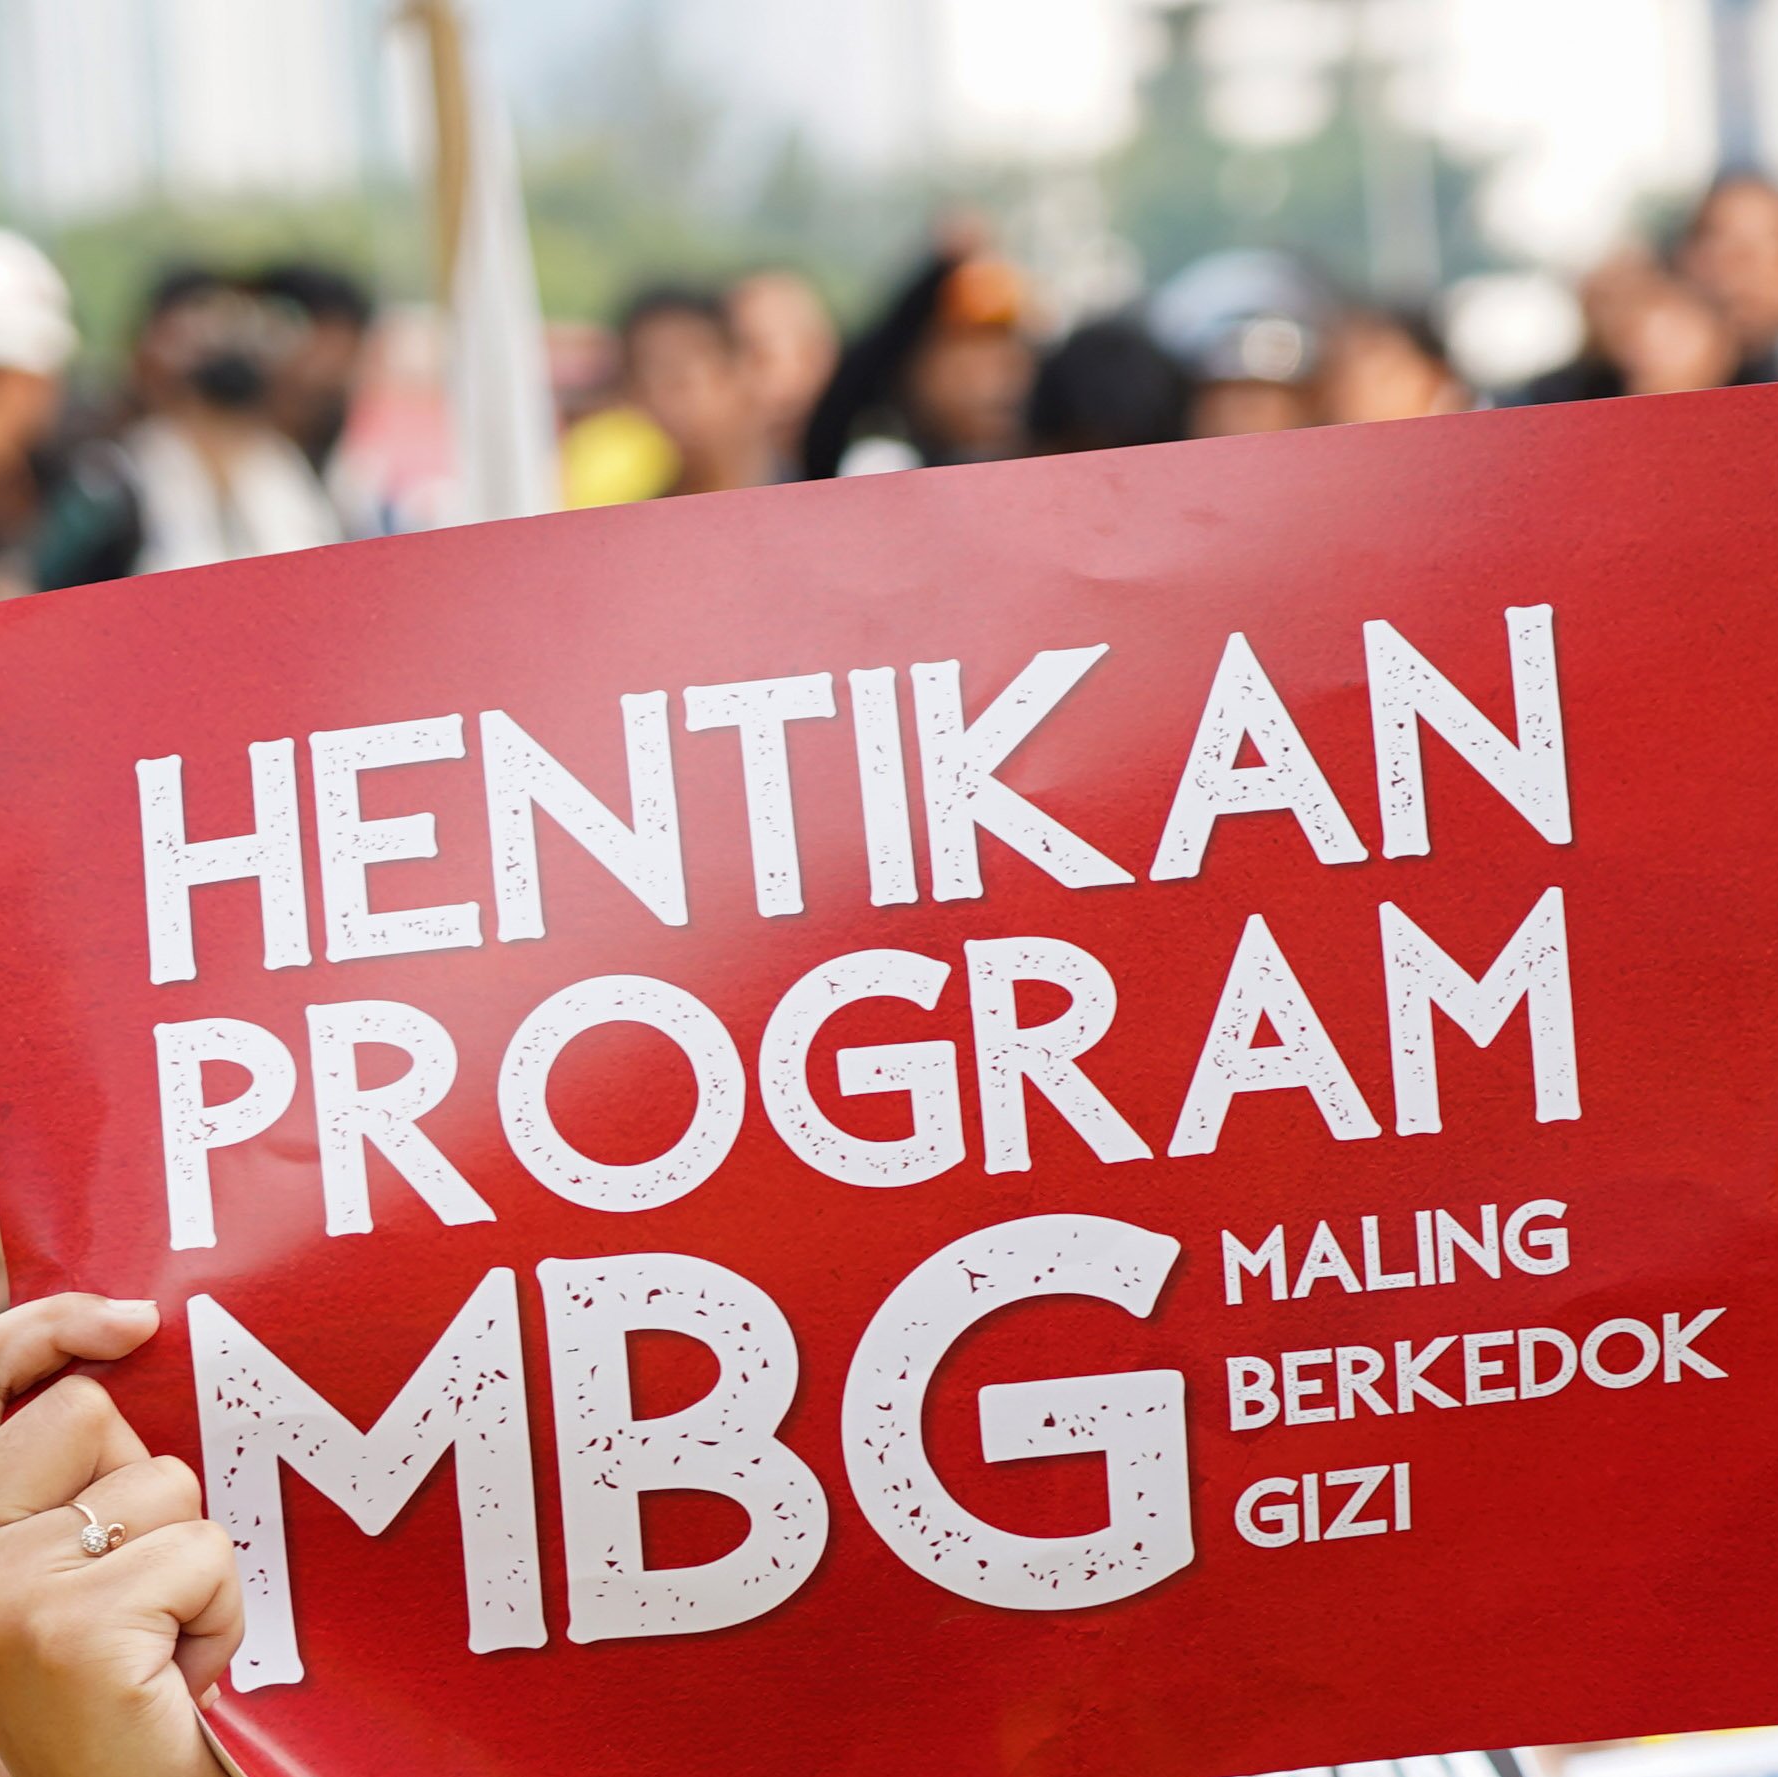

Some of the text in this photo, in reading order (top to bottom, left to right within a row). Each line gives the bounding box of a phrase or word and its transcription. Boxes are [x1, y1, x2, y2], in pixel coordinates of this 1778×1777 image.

[135, 603, 1573, 985] HENTIKAN
[153, 886, 1582, 1254] PROGRAM
[1221, 1198, 1570, 1306] MALING
[1226, 1307, 1728, 1432] BERKEDOK
[186, 1213, 1195, 1693] MBG
[1234, 1462, 1411, 1549] GIZI
